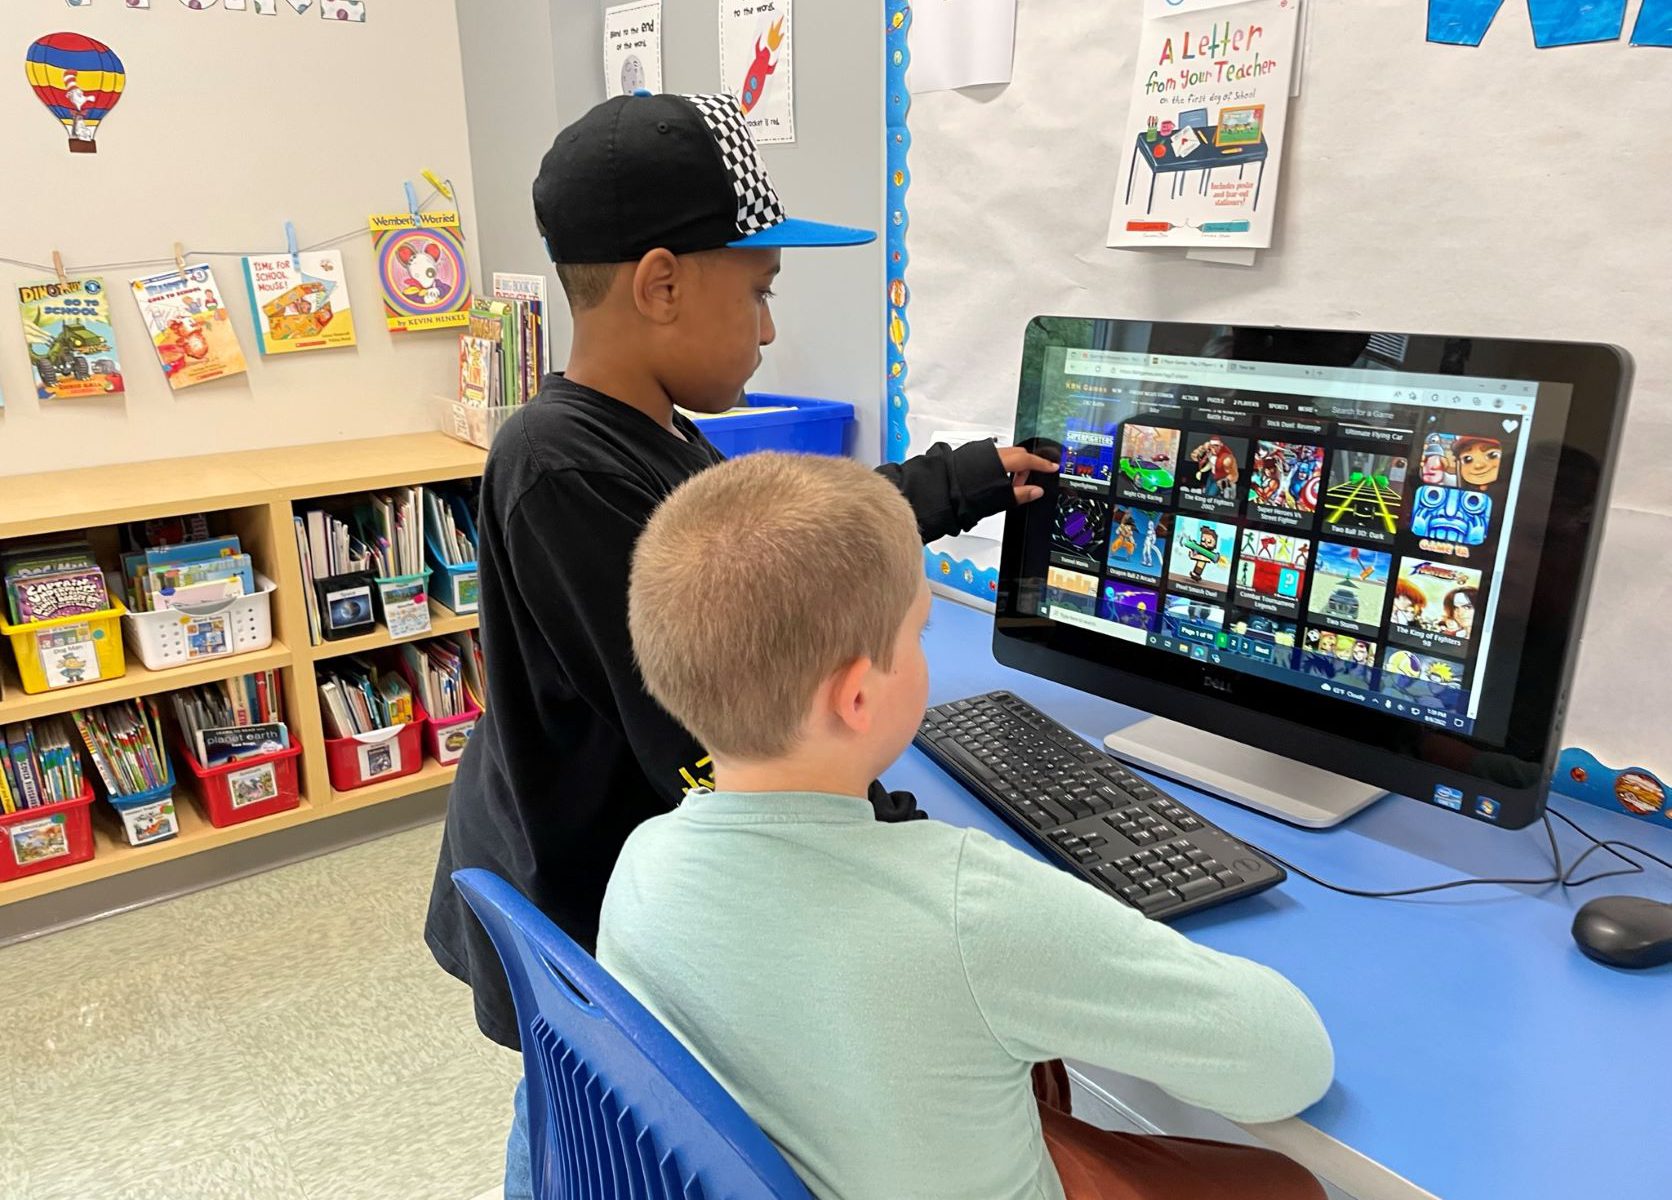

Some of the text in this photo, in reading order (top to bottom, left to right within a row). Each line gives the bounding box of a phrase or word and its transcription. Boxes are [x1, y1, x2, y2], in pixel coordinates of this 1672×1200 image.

[641, 19, 655, 32] end
[1159, 21, 1263, 65] A Letter
[1145, 52, 1277, 95] from your Teacher
[1172, 95, 1184, 104] the
[420, 213, 455, 224] Worried
[254, 260, 290, 272] TIME FOR
[256, 271, 288, 282] SCHOOL
[258, 281, 288, 292] MOUSE!
[44, 306, 98, 316] SCHOOL
[408, 317, 433, 326] KEVIN
[436, 313, 466, 324] HENKES
[1331, 406, 1355, 415] Search
[1373, 410, 1395, 420] Game
[1396, 626, 1408, 635] The
[1409, 629, 1426, 640] King
[1434, 634, 1461, 646] Fighters
[1203, 676, 1233, 694] DELL
[207, 734, 244, 746] planet
[246, 730, 278, 741] earth
